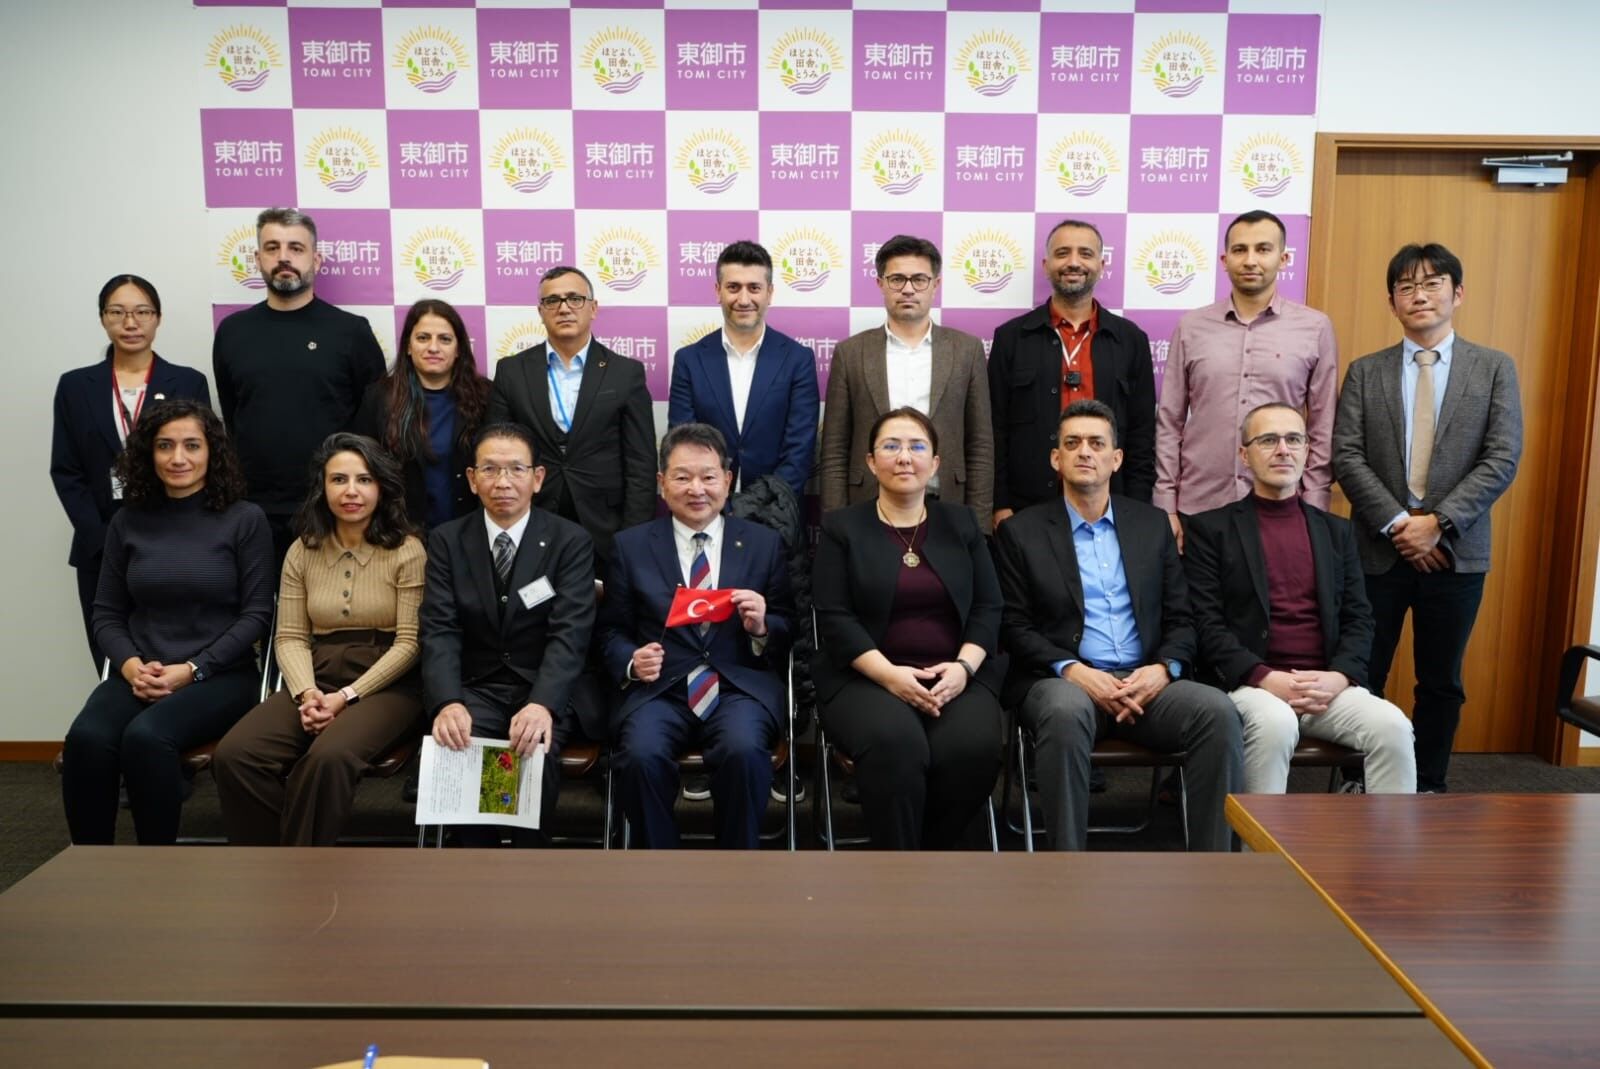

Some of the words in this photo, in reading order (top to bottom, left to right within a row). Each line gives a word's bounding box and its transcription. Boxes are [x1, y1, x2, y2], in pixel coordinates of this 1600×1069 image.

[302, 40, 371, 64] 東御市
[490, 41, 559, 65] 東御市
[677, 42, 746, 66] 東御市
[864, 43, 934, 68] 東御市
[1051, 45, 1120, 69] 東御市
[1238, 46, 1307, 70] 東御市
[303, 68, 337, 77] TOMI
[341, 68, 373, 78] CITY
[489, 69, 523, 78] TOMI
[529, 69, 560, 78] CITY
[677, 70, 711, 78] TOMI
[716, 70, 747, 79] CITY
[863, 71, 897, 80] TOMI
[903, 71, 933, 80] CITY
[1050, 72, 1084, 82] TOMI
[1089, 73, 1120, 82] CITY
[1236, 74, 1270, 83] TOMI
[1275, 74, 1305, 84] CITY
[214, 140, 283, 164] 東御市
[400, 142, 468, 165] 東御市
[586, 142, 654, 166] 東御市
[771, 144, 840, 166] 東御市
[956, 145, 1024, 168] 東御市
[1141, 146, 1210, 170] 東御市
[215, 168, 249, 176] TOMI
[254, 168, 284, 176] CITY
[400, 168, 434, 178] TOMI
[439, 168, 469, 178] CITY
[585, 169, 619, 178] TOMI
[625, 170, 655, 178] CITY
[771, 170, 804, 179] TOMI
[809, 170, 840, 179] CITY
[955, 172, 989, 181] TOMI
[994, 172, 1025, 181] CITY
[1140, 173, 1173, 182] TOMI
[1179, 173, 1209, 182] CITY
[496, 240, 564, 264] 東御市
[679, 241, 729, 264] 東御
[317, 267, 345, 276] OMI
[352, 267, 381, 276] CITY
[496, 267, 529, 276] TOMI
[679, 268, 712, 277] TOMI
[1276, 272, 1294, 280] ITY
